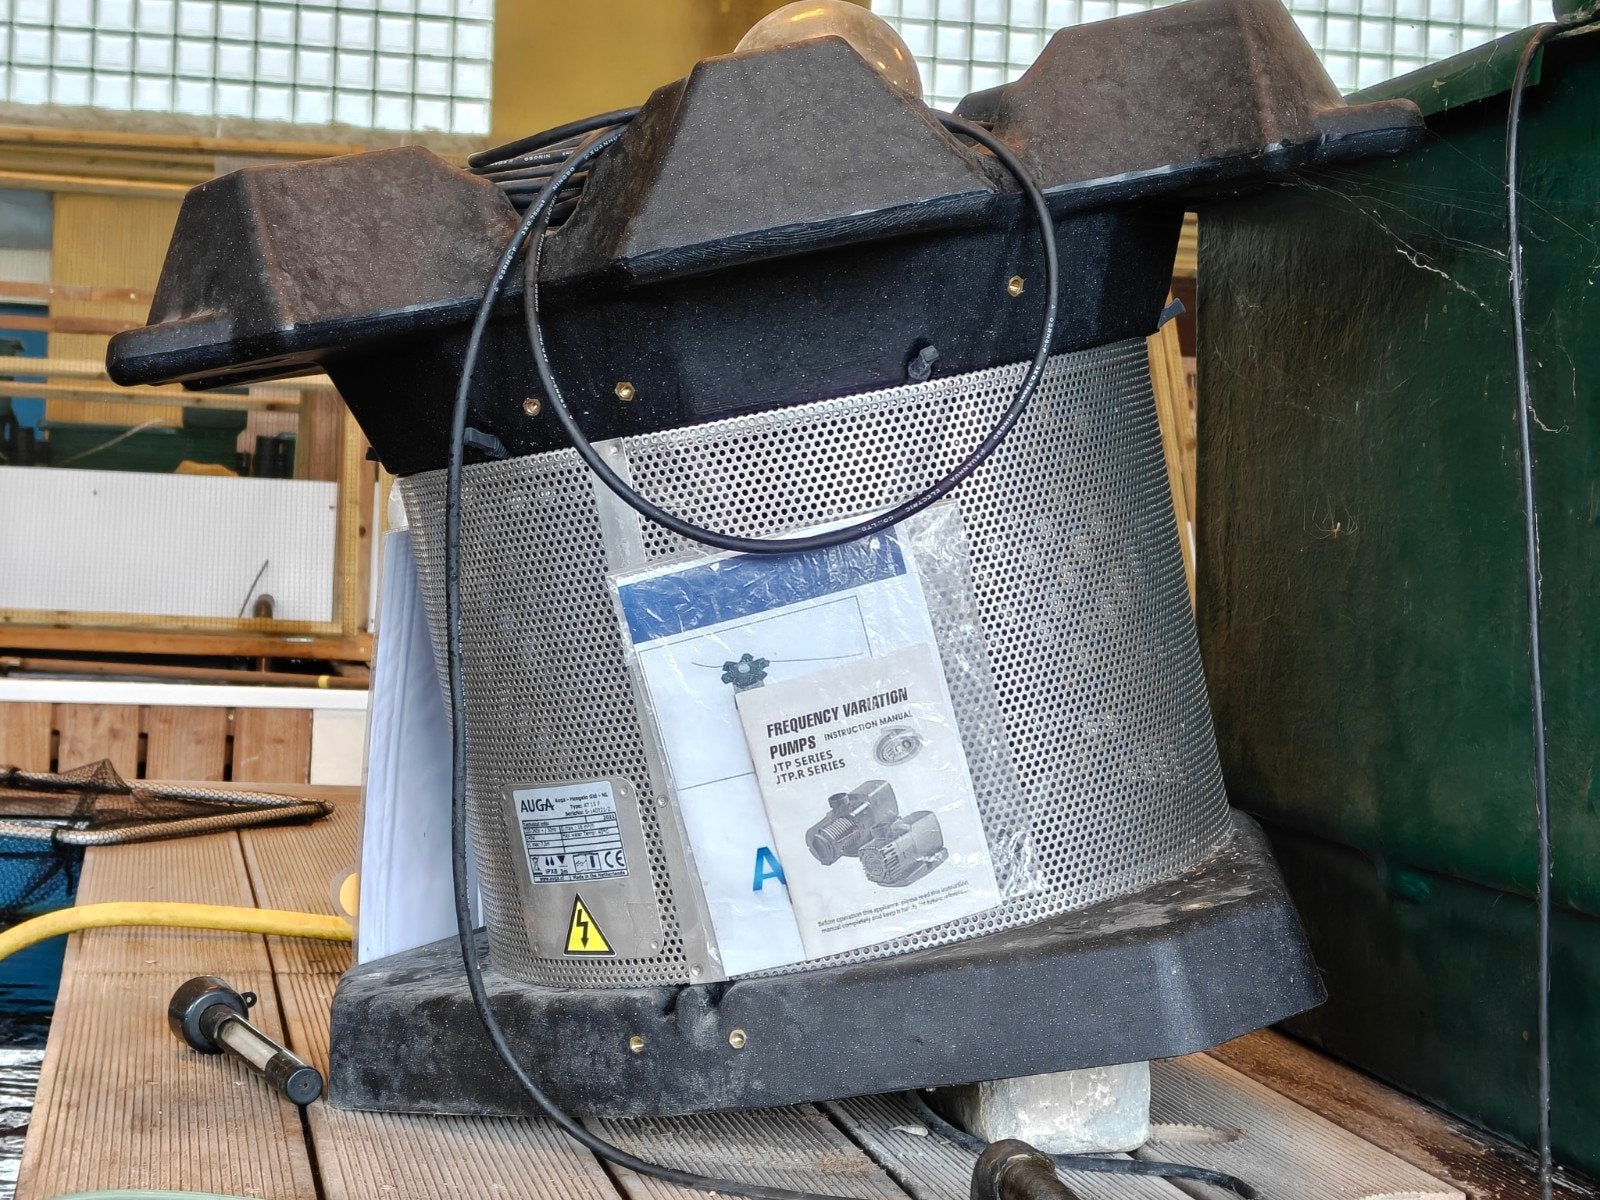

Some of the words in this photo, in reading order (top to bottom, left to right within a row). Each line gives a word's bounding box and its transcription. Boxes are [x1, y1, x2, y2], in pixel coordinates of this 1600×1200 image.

[552, 166, 575, 191] NINGBO
[993, 413, 1015, 440] NINGBO
[951, 452, 983, 482] XUANHUA
[905, 487, 941, 513] ELECTRIC
[767, 707, 839, 738] FREQUENCY
[843, 686, 909, 718] VARIATION
[769, 735, 817, 760] PUMPS
[823, 720, 878, 742] INSTRUCTION
[879, 710, 914, 728] MANUAL
[773, 761, 793, 774] JTP
[794, 750, 834, 768] SERIES
[775, 768, 806, 785] JTP.R
[808, 758, 846, 777] SERIES
[520, 798, 555, 813] AUGA
[753, 846, 787, 891] A
